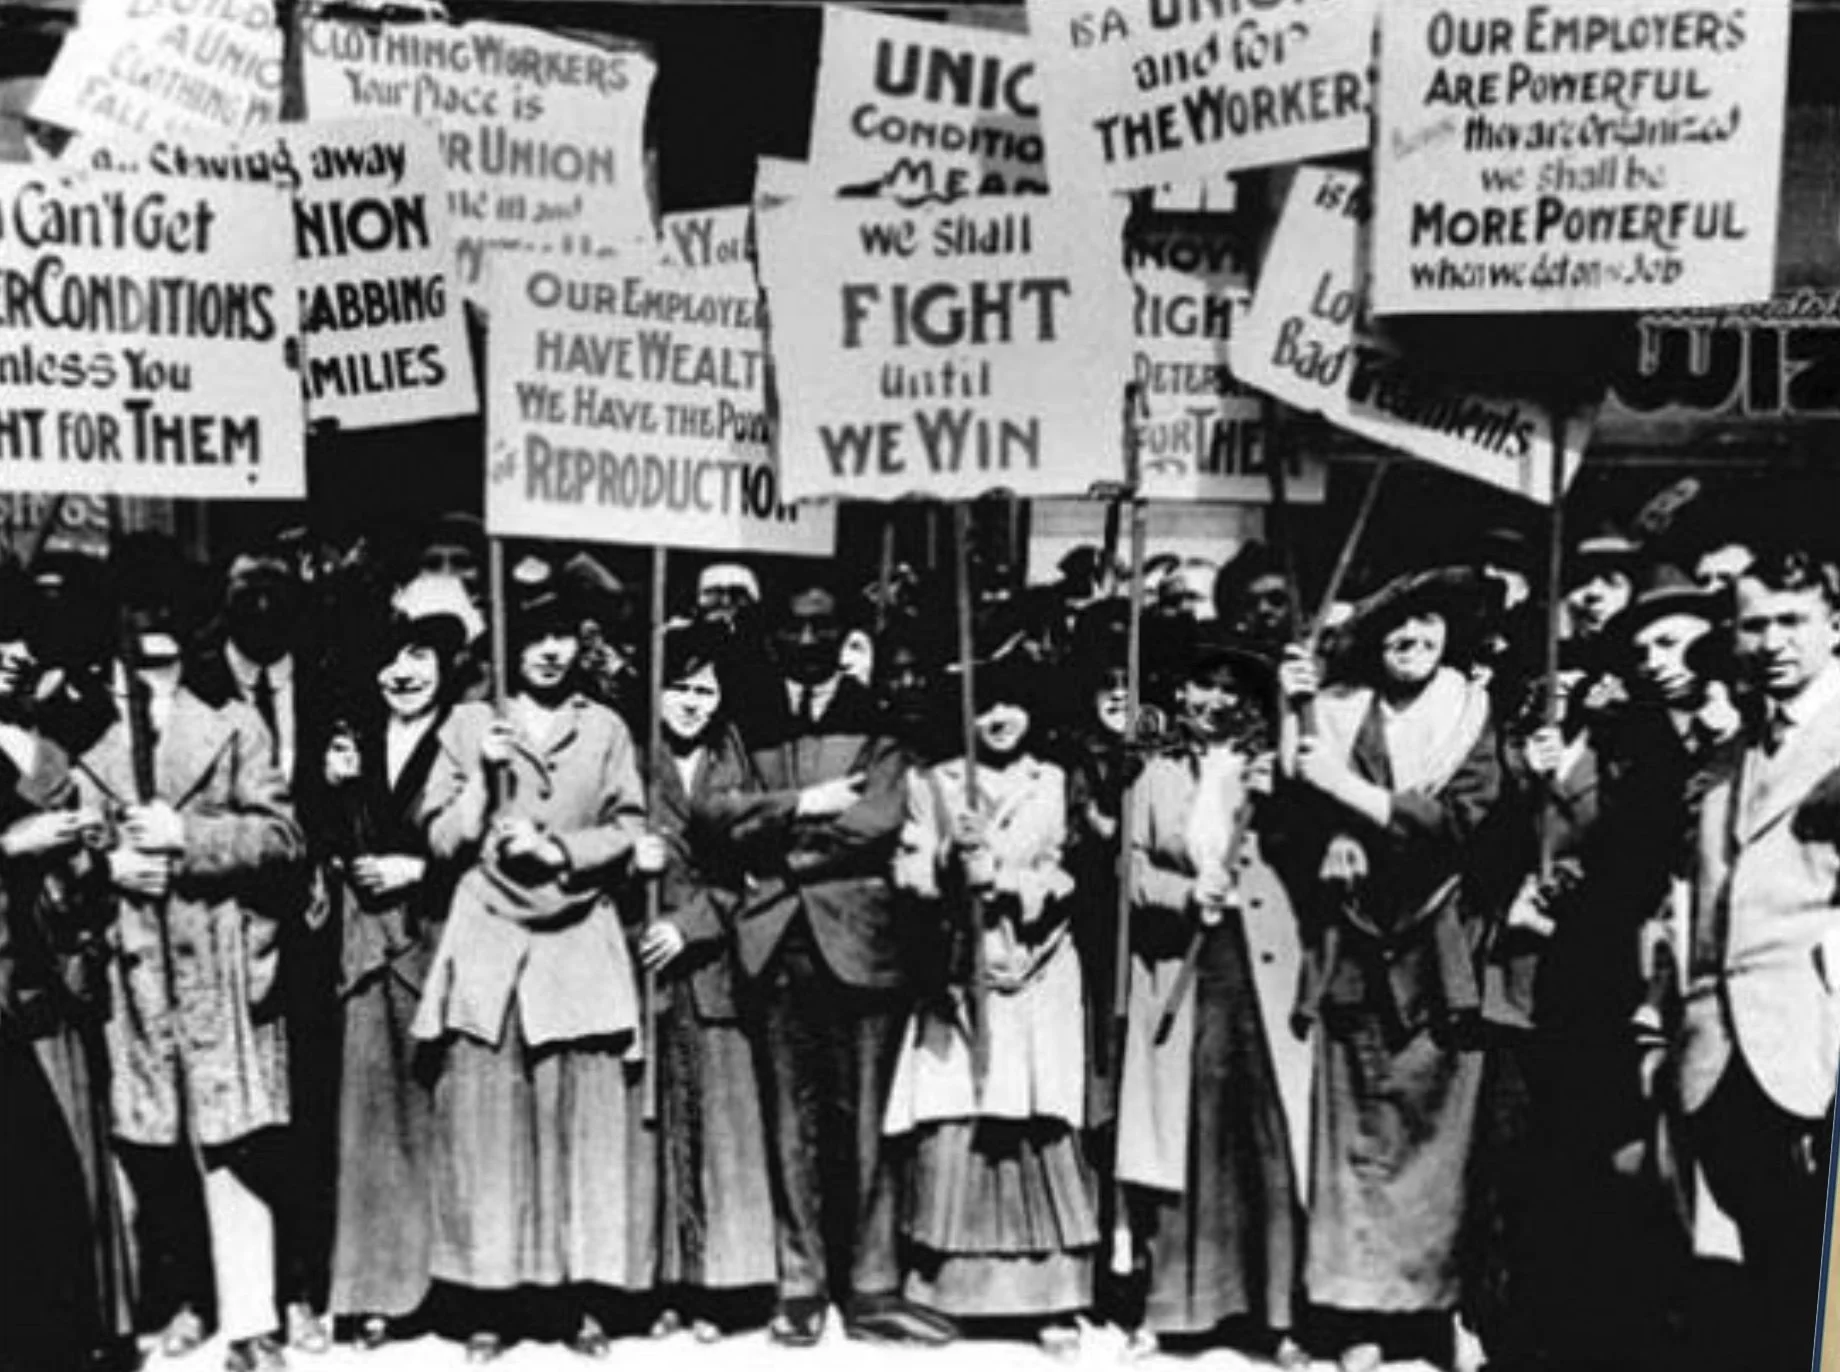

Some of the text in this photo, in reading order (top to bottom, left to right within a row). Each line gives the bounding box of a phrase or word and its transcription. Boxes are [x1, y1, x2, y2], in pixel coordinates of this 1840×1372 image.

[1101, 7, 1129, 43] A
[1427, 5, 1746, 57] OUR EMPLOYERS
[471, 33, 630, 94] WORKERS
[1423, 62, 1711, 113] ARE POWERFUL
[512, 83, 545, 120] is
[438, 124, 615, 186] R UNION
[1093, 103, 1183, 164] THE
[309, 142, 407, 187] away
[131, 190, 216, 254] Get
[1410, 200, 1530, 249] MORE
[1534, 195, 1748, 252] POWERFUL
[298, 272, 447, 335] ABBING
[525, 270, 765, 330] OUR EMPLOYE
[841, 276, 1071, 349] FIGHT
[122, 348, 193, 392] You
[535, 329, 634, 381] HAVE
[515, 381, 568, 424] WE
[572, 384, 659, 434] HAVE
[58, 409, 123, 463] FOR
[818, 406, 1041, 477] WE WIN
